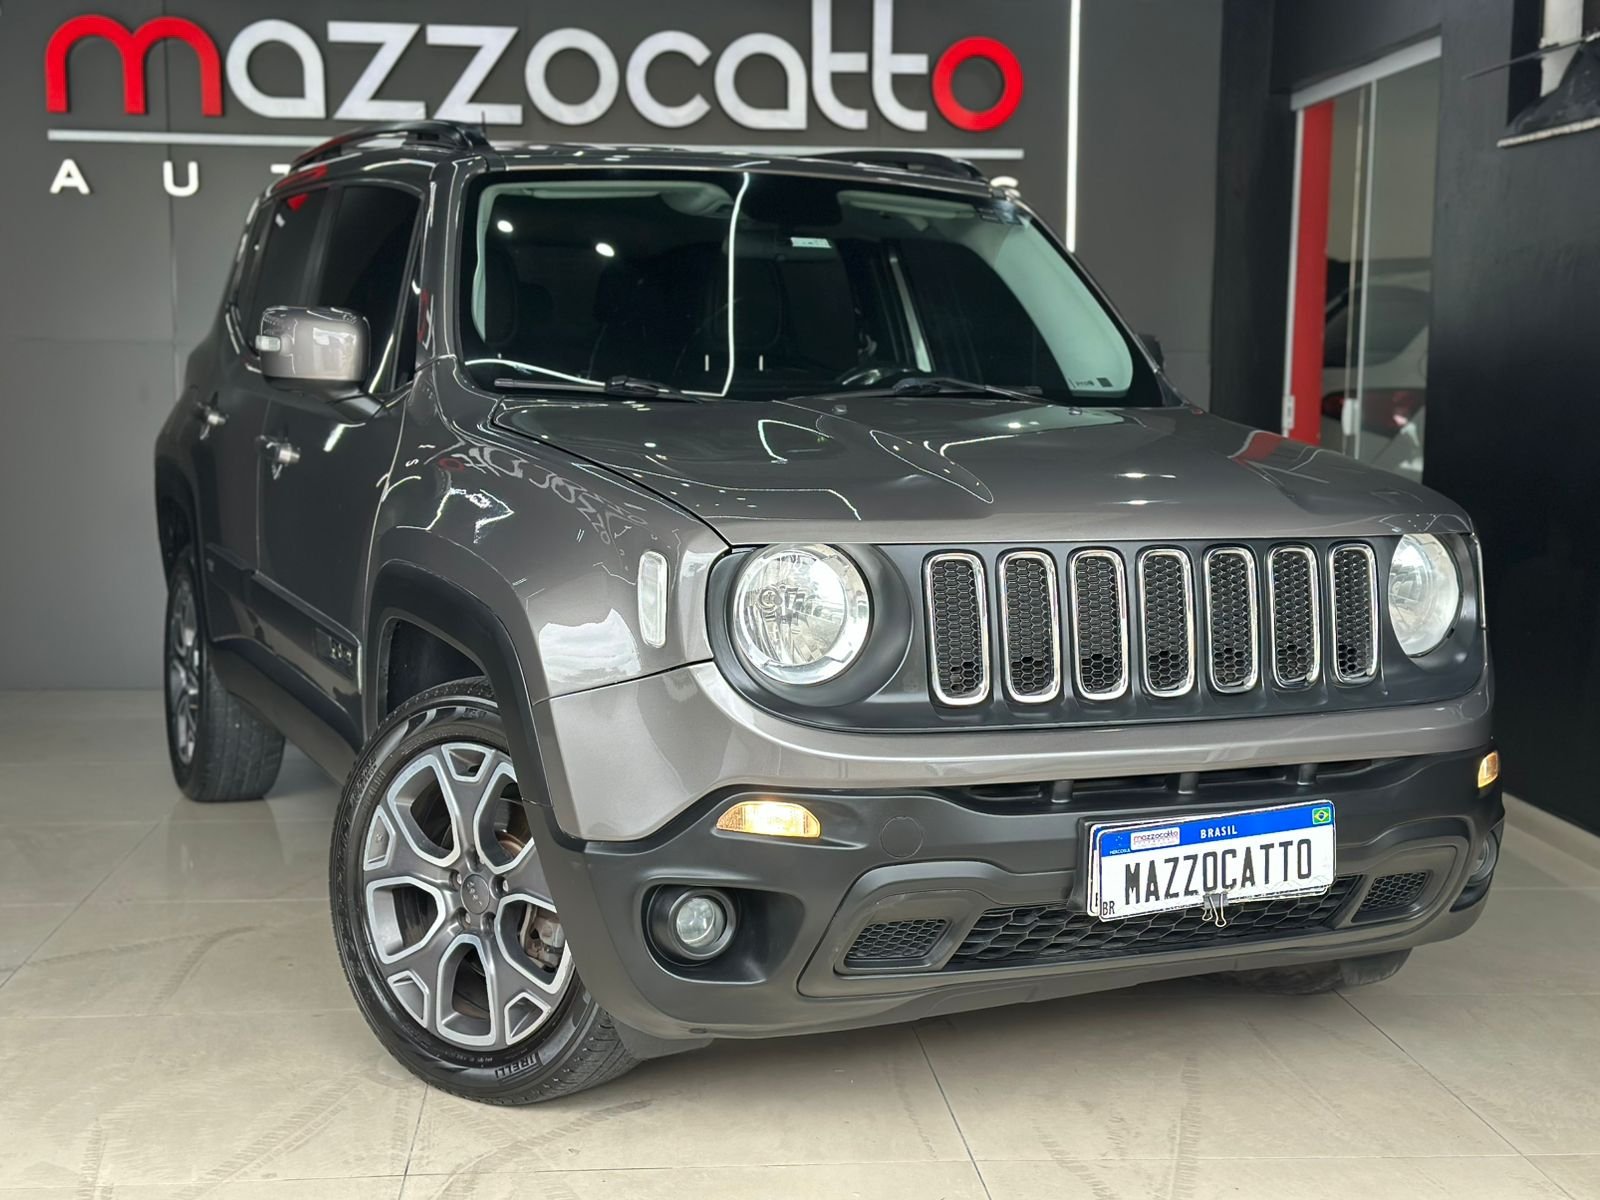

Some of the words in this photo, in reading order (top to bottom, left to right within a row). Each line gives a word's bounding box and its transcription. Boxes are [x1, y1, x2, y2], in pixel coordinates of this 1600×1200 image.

[45, 0, 1023, 133] mazzocatto
[1200, 825, 1238, 839] BRASIL
[1124, 838, 1312, 906] MAZZOCATTO
[1102, 900, 1116, 915] BR
